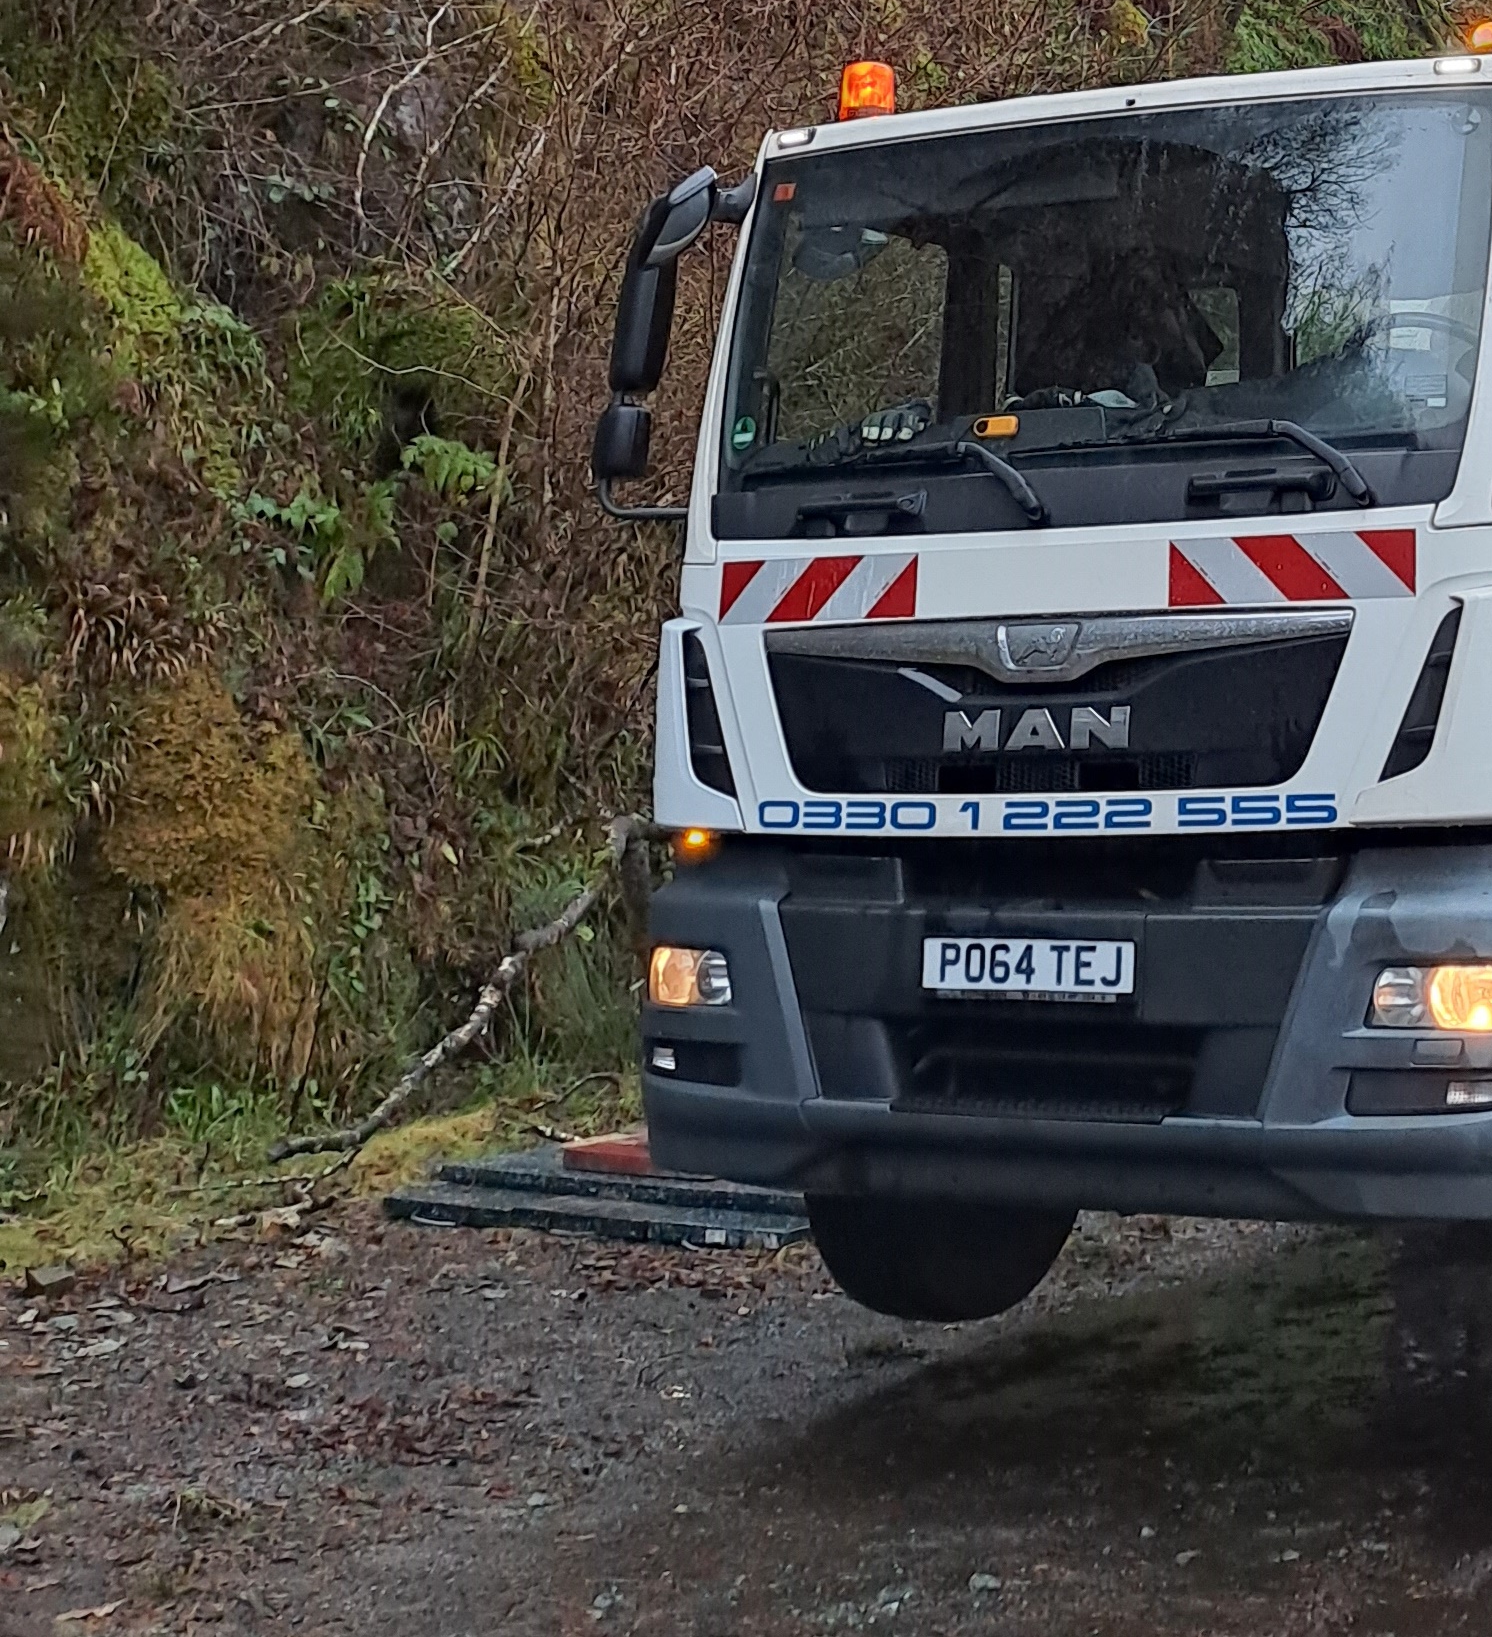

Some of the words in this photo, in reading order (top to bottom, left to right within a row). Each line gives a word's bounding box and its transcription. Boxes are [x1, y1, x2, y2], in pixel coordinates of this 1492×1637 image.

[942, 705, 1131, 751] MAN
[759, 800, 936, 830] 0330
[958, 802, 980, 831] 1
[1003, 798, 1152, 830] 222
[1177, 793, 1337, 828] 555
[939, 942, 1036, 985] PO64
[1050, 944, 1123, 987] TEJ
